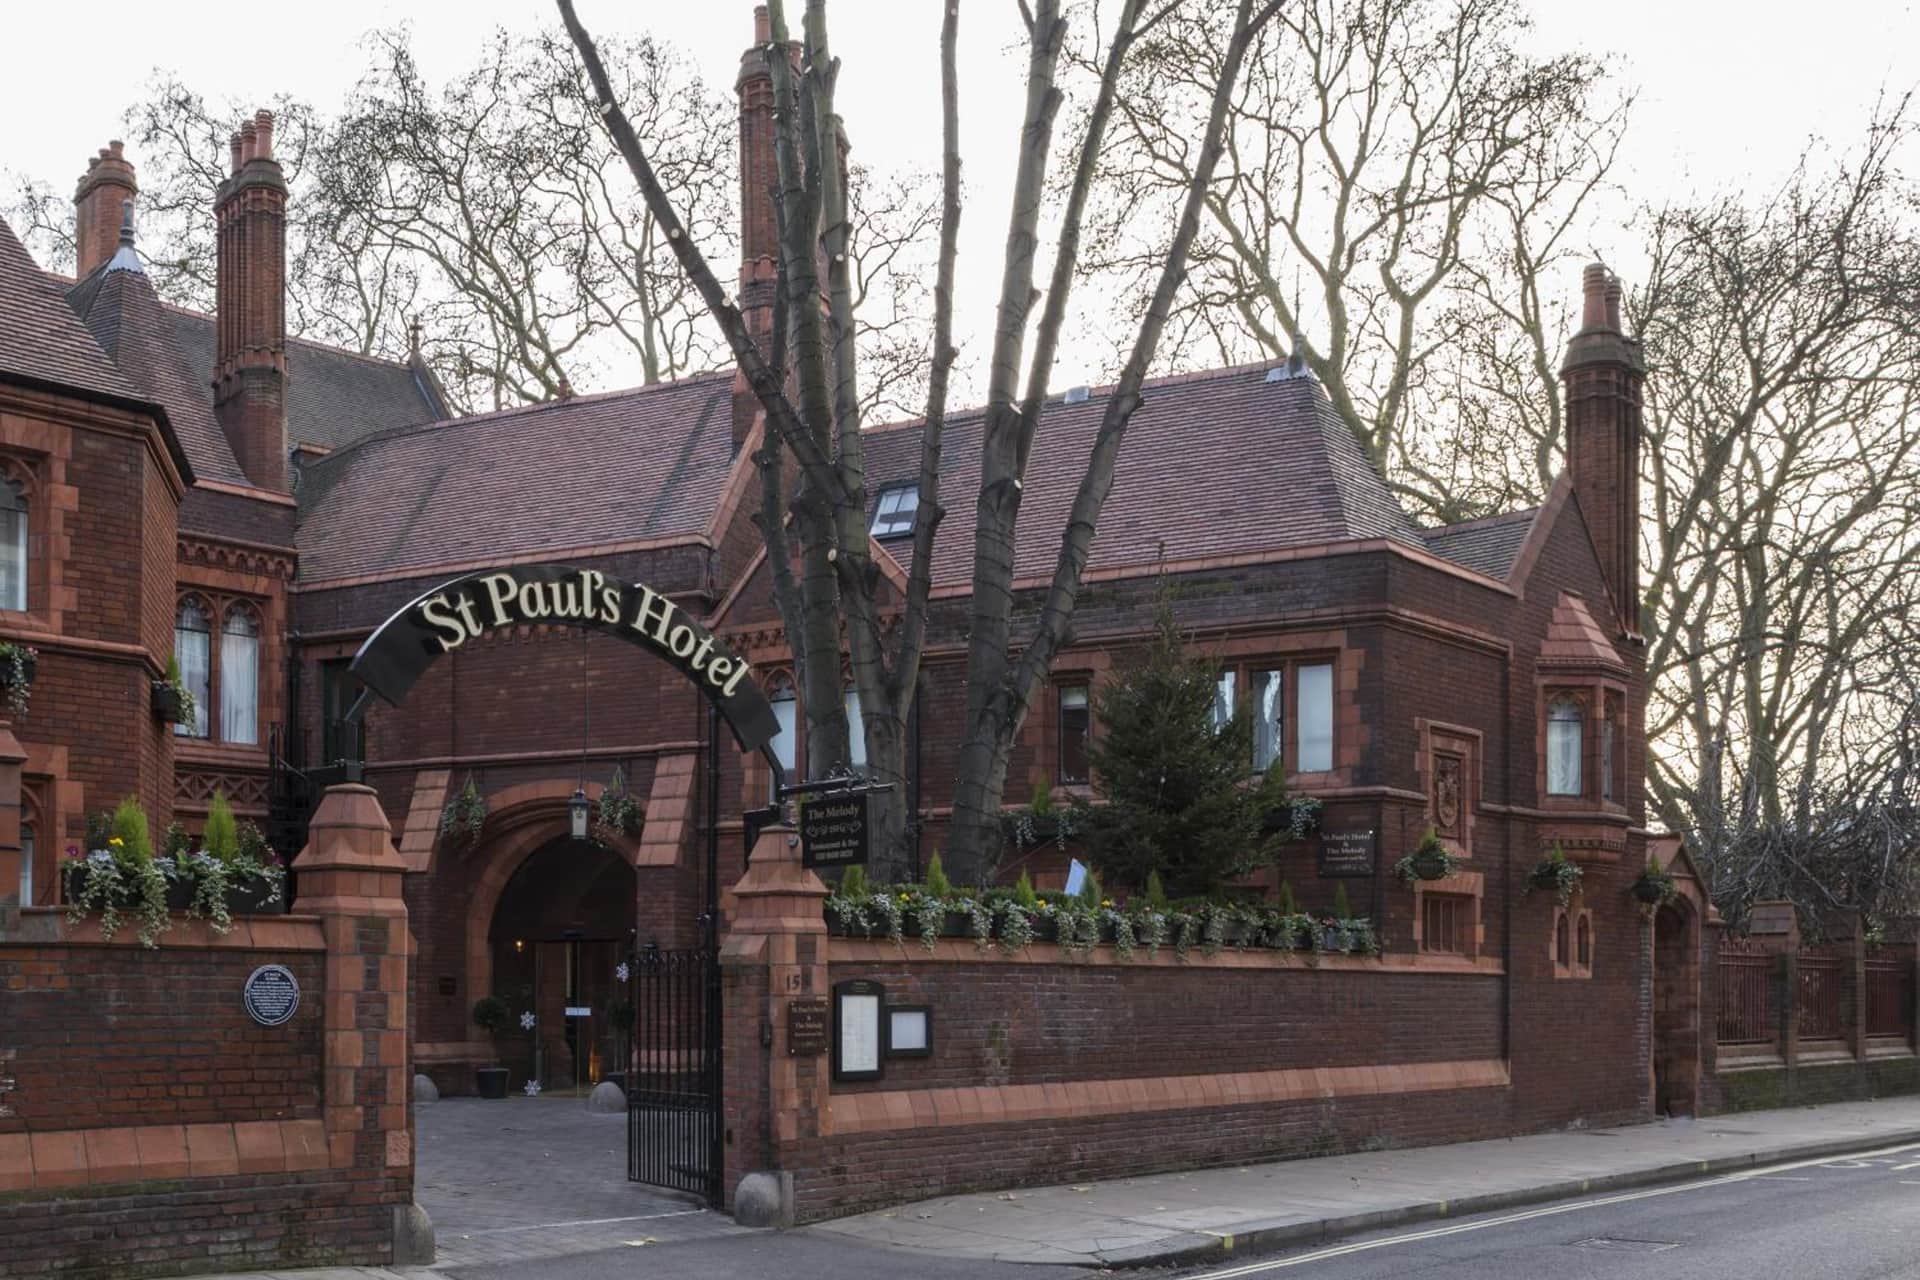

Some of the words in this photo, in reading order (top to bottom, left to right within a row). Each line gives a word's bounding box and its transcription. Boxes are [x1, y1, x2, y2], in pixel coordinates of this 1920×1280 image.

[423, 594, 484, 653] St
[480, 570, 621, 627] Paul's
[630, 583, 750, 698] Hotel
[808, 808, 825, 820] The
[825, 803, 860, 818] Melody
[786, 974, 801, 991] 15
